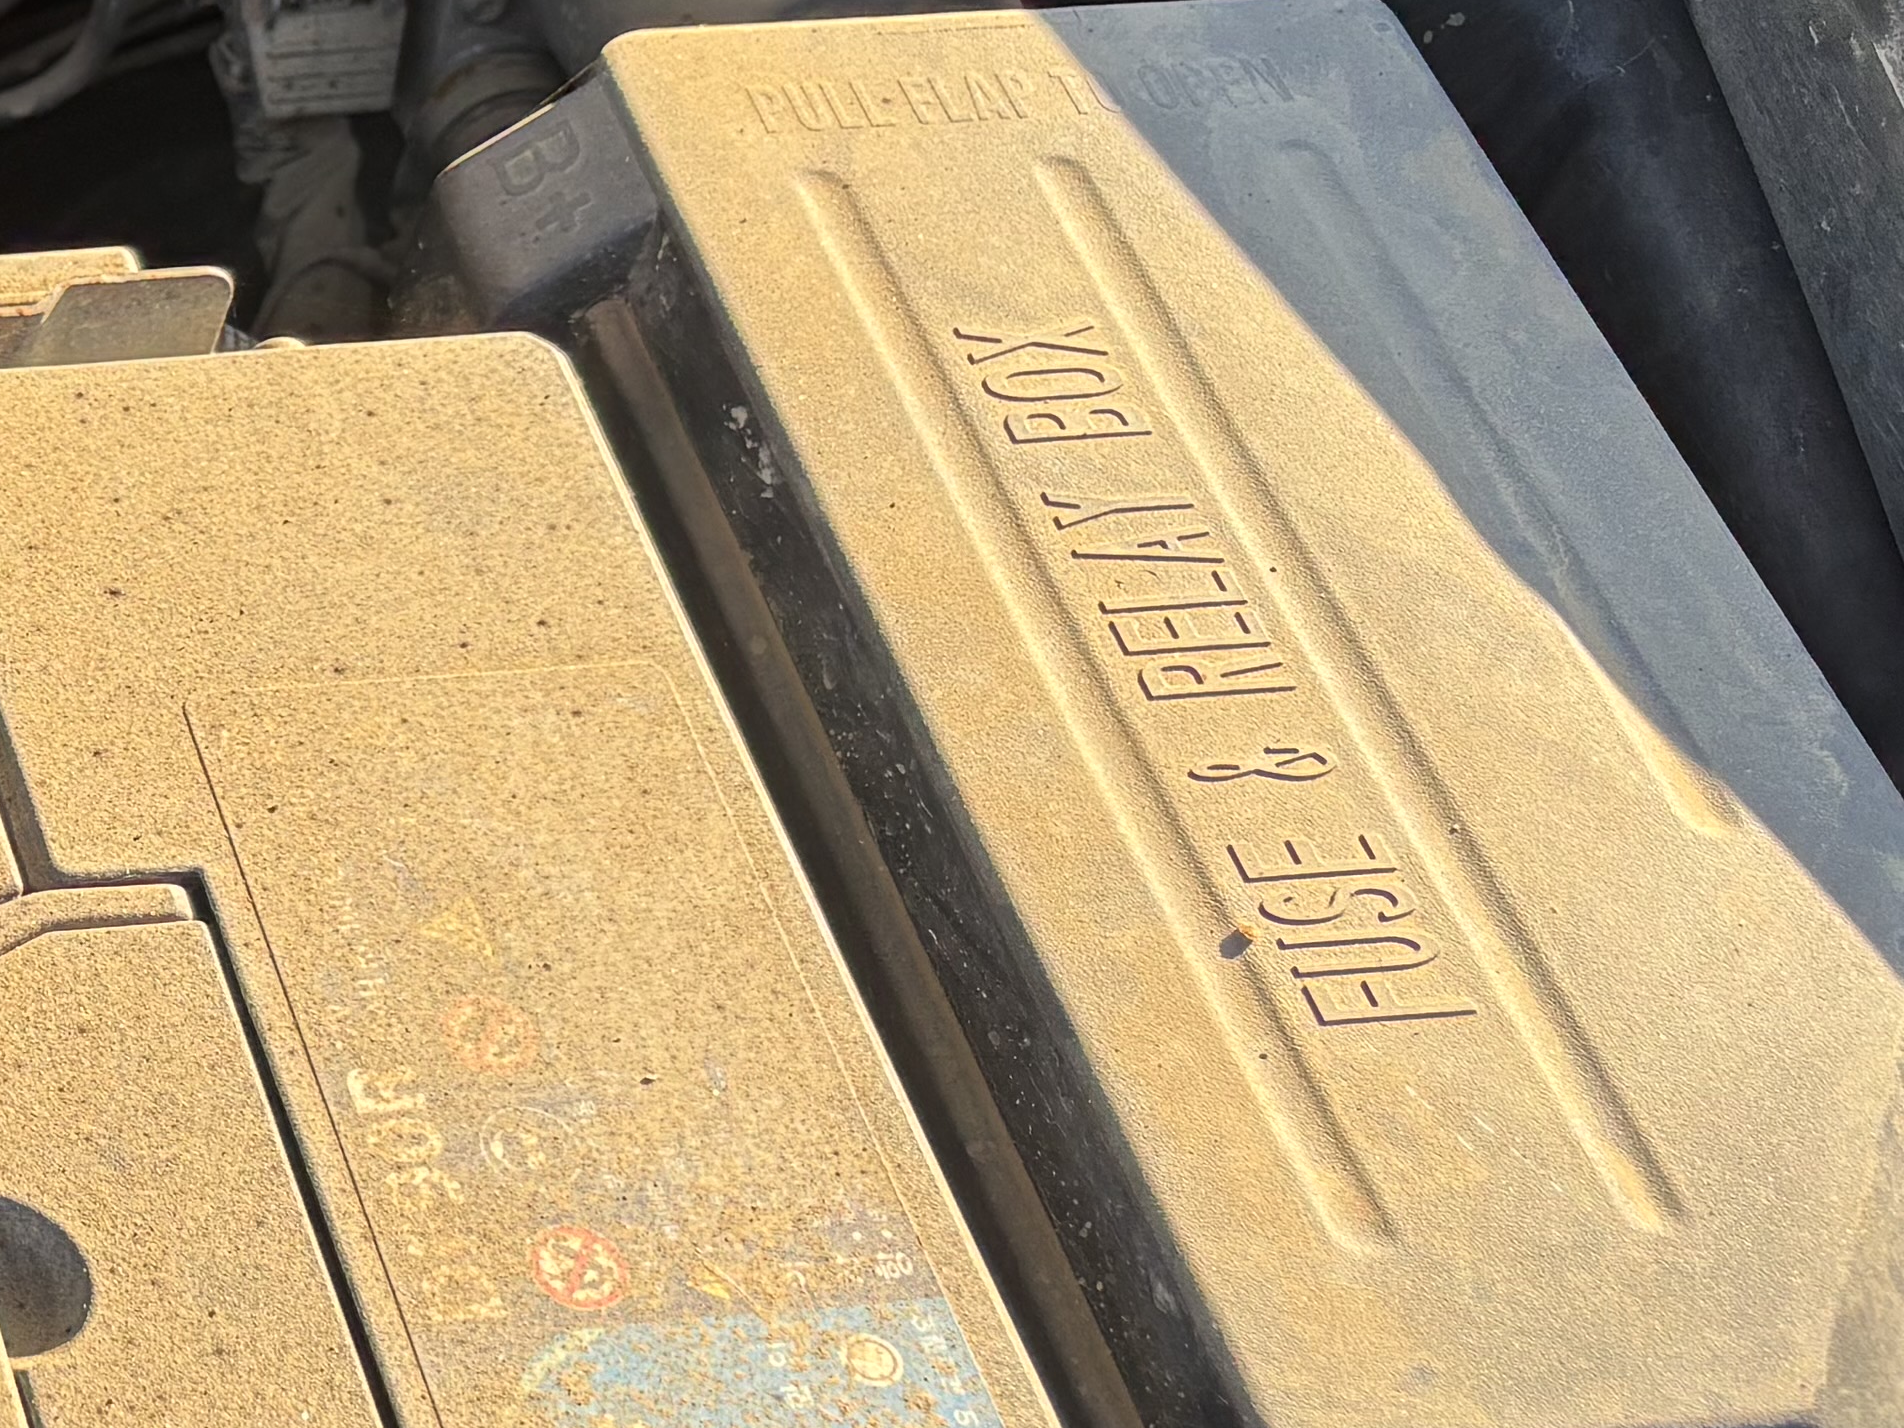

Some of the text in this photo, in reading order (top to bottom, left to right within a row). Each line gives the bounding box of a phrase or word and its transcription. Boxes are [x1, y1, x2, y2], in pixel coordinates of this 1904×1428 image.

[745, 57, 1296, 134] PULL FLAP TO OPEN
[952, 324, 1479, 1028] FUSE & RELAY BOX
